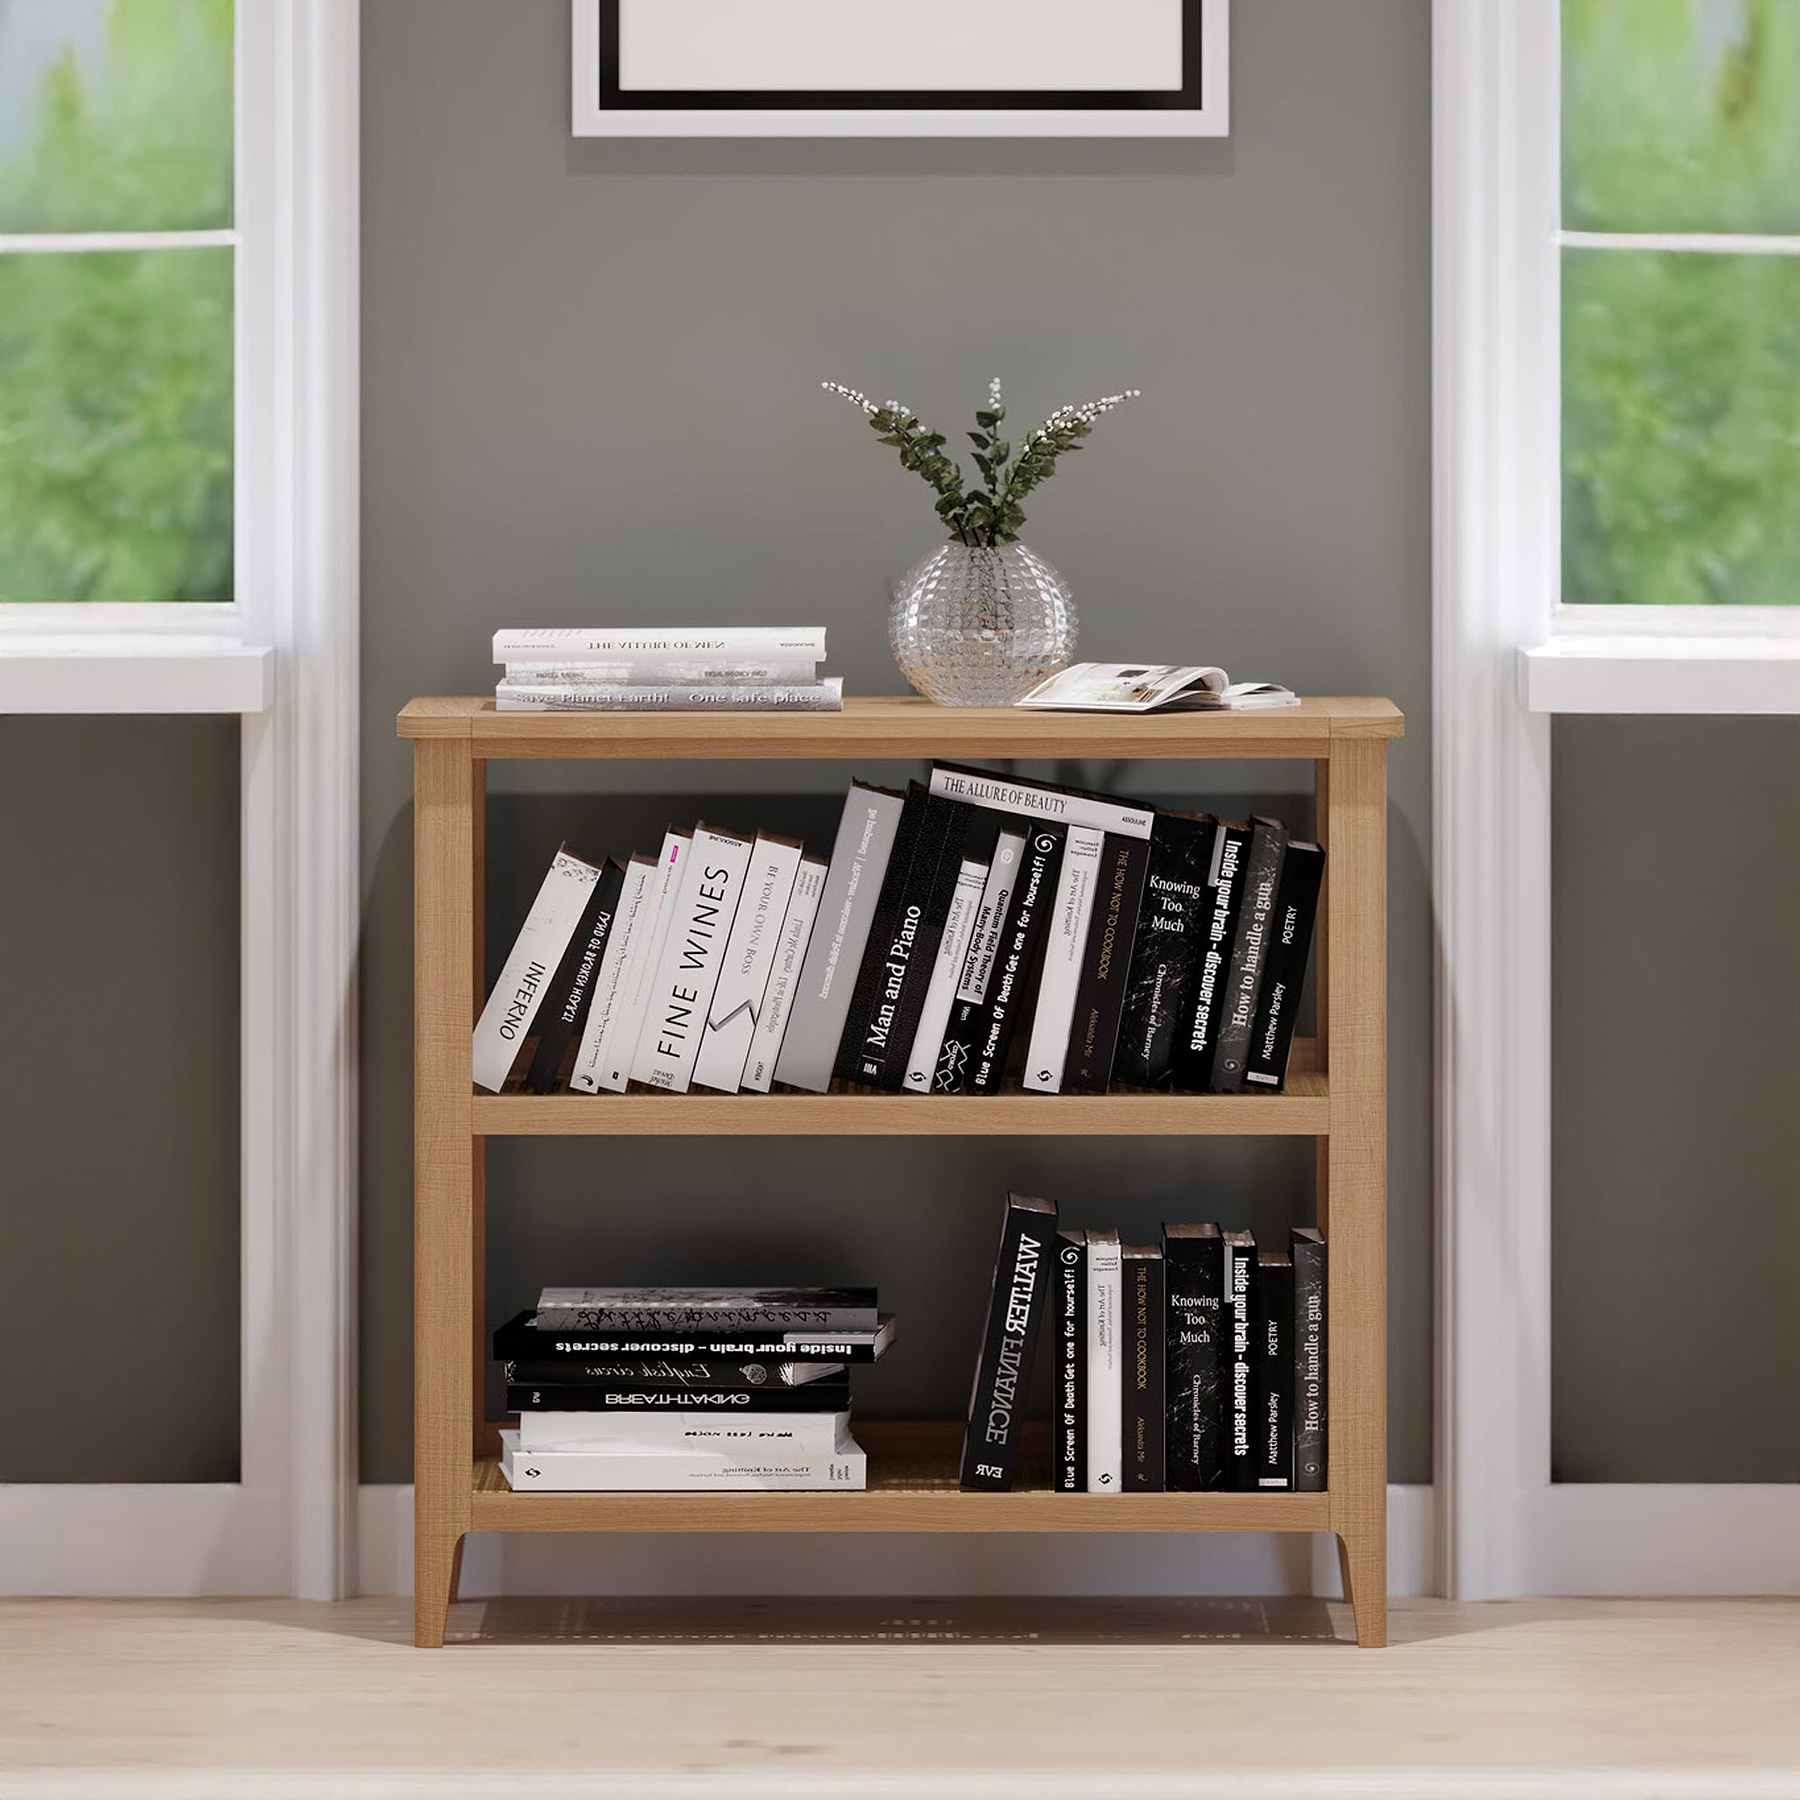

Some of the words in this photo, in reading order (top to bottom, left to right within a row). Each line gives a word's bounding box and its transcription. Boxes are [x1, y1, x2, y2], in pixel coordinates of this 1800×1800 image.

[516, 693, 554, 703] Save
[563, 692, 613, 703] Planet
[619, 692, 670, 703] Earth!
[689, 693, 725, 703] One
[731, 693, 768, 703] safe
[774, 693, 821, 705] place
[944, 776, 965, 794] THE
[965, 782, 1007, 801] ALLURE
[1008, 789, 1023, 804] OF
[1024, 792, 1067, 813] BEAUTY
[767, 865, 778, 877] BE
[1117, 850, 1129, 866] THE
[1220, 839, 1242, 877] Inside
[1022, 855, 1045, 906] hourself!
[1113, 867, 1125, 891] HOW
[1149, 874, 1200, 899] Knowing
[1214, 877, 1232, 909] your
[757, 882, 773, 910] YOUR
[991, 889, 1008, 928] Quantum
[1109, 892, 1121, 912] NOT
[1161, 896, 1182, 912] Too
[1253, 880, 1276, 911] gun
[749, 913, 765, 945] OWN
[967, 905, 991, 954] Many-Body
[1016, 909, 1030, 927] for
[1106, 914, 1118, 926] TO
[1151, 915, 1184, 932] Much
[1209, 908, 1230, 941] brain
[1252, 910, 1267, 922] a
[1281, 905, 1296, 944] POETRY
[889, 905, 920, 960] Piano
[985, 930, 998, 952] Field
[1013, 932, 1025, 950] one
[656, 984, 697, 1057] FINE
[679, 866, 728, 968] WINES
[741, 948, 756, 974] BOSS
[1097, 927, 1115, 979] COOKBOOK
[1238, 921, 1265, 974] handle
[957, 955, 979, 991] Systems
[974, 954, 991, 982] Theory
[1005, 954, 1019, 972] Get
[885, 961, 905, 999] and
[973, 983, 982, 995] of
[996, 973, 1014, 1002] Death
[1149, 963, 1167, 1013] Chronicles
[1198, 951, 1222, 1005] discover
[1236, 973, 1256, 992] to
[499, 961, 545, 1040] INFERNO
[992, 1005, 1004, 1019] Of
[1229, 990, 1252, 1028] How
[866, 1004, 895, 1047] Man
[1190, 1004, 1209, 1051] secrets
[1261, 1016, 1277, 1059] Matthew
[1269, 982, 1286, 1015] Parsley
[982, 1022, 1001, 1057] Screen
[1142, 1026, 1157, 1060] Barney
[974, 1061, 990, 1085] Blue
[1137, 1267, 1147, 1282] THE
[1234, 1257, 1250, 1292] Inside
[1064, 1269, 1075, 1317] hourself!
[1137, 1284, 1147, 1305] HOW
[1171, 1294, 1219, 1310] Knowing
[1137, 1307, 1147, 1325] NOT
[1184, 1313, 1206, 1325] Too
[1230, 1294, 1247, 1322] your
[1308, 1295, 1322, 1322] gun
[1063, 1320, 1075, 1338] for
[1137, 1328, 1147, 1339] TO
[1180, 1330, 1210, 1343] Much
[1234, 1322, 1250, 1353] brain
[1268, 1319, 1278, 1356] POETRY
[1308, 1322, 1319, 1332] a
[555, 1342, 619, 1354] secrets
[621, 1342, 695, 1354] discover
[711, 1342, 755, 1355] brain
[756, 1341, 797, 1354] your
[800, 1341, 852, 1355] Inside
[1066, 1341, 1075, 1359] one
[1304, 1331, 1319, 1381] handle
[1064, 1363, 1075, 1380] Get
[1137, 1340, 1147, 1390] COOKBOOK
[1064, 1381, 1075, 1409] Death
[1193, 1374, 1201, 1422] Chronicles
[1234, 1362, 1250, 1412] discover
[1306, 1383, 1319, 1397] to
[1063, 1413, 1075, 1425] Of
[1268, 1392, 1280, 1423] Parsley
[1305, 1397, 1319, 1431] How
[1193, 1422, 1203, 1434] of
[1234, 1412, 1250, 1456] secrets
[1064, 1429, 1075, 1462] Screen
[1191, 1434, 1201, 1465] Barney
[1268, 1423, 1278, 1465] Matthew
[1064, 1466, 1075, 1489] Blue
